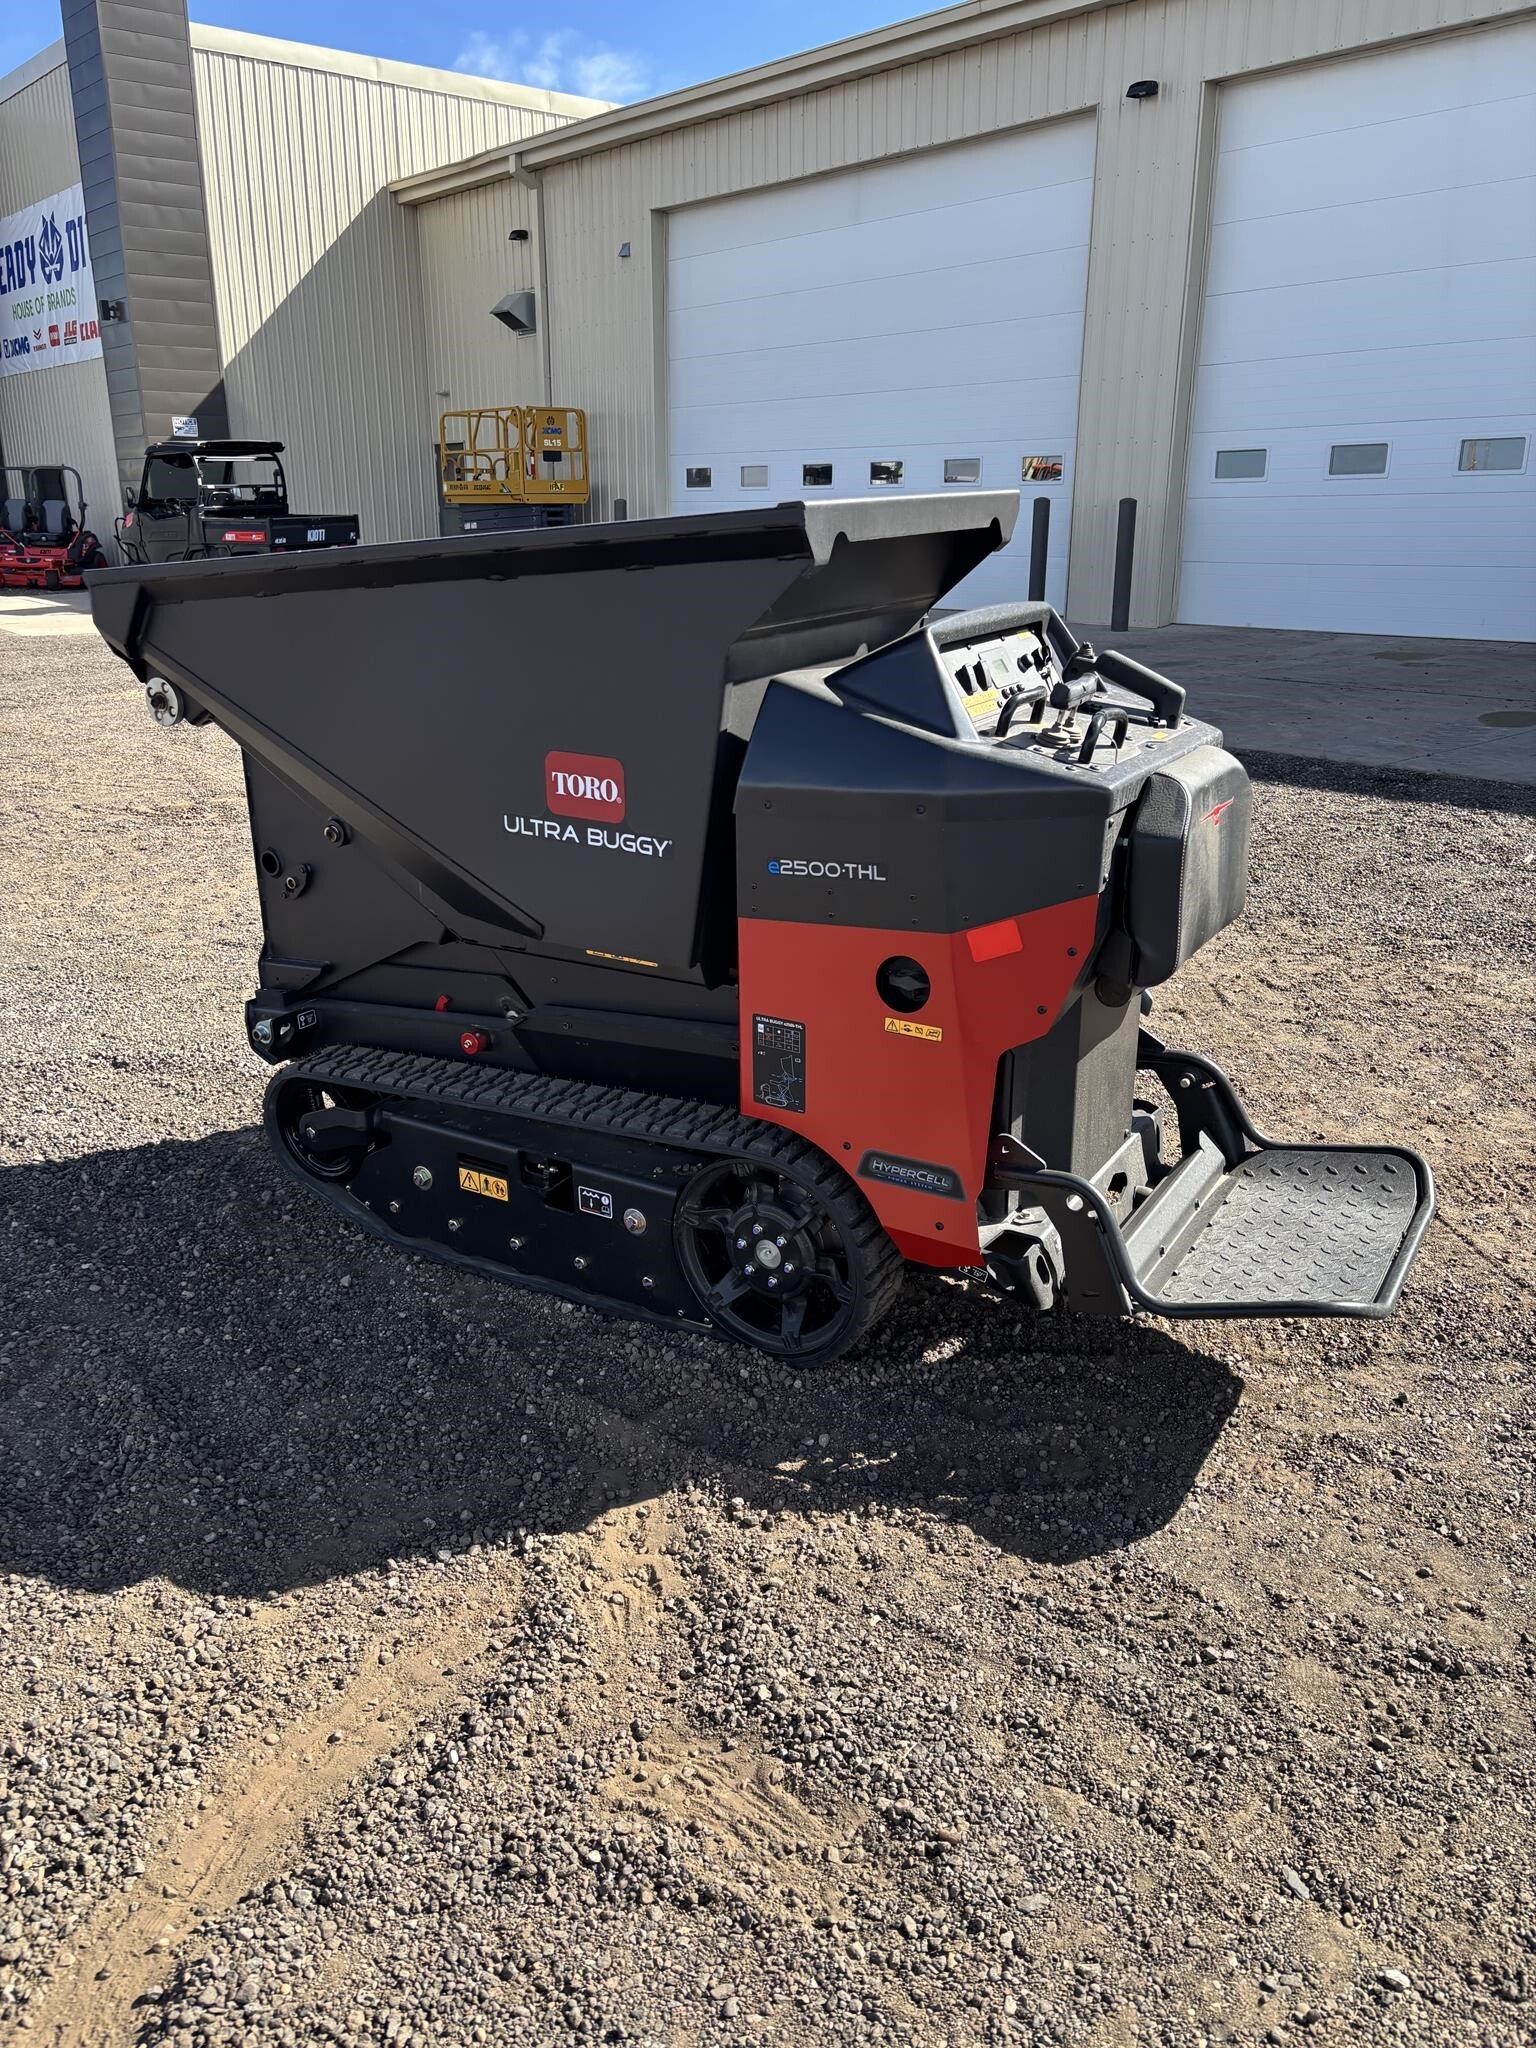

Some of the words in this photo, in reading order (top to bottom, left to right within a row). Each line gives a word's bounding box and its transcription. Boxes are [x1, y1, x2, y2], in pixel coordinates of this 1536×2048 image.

[12, 299, 34, 320] HOUSE
[35, 296, 45, 314] OF
[47, 287, 77, 311] BRANDS
[10, 336, 31, 357] XCMG
[64, 320, 77, 337] JLG
[307, 529, 325, 542] KIOTI
[551, 771, 619, 803] TORO
[503, 815, 579, 844] ULTRA
[587, 827, 672, 857] BUGGY
